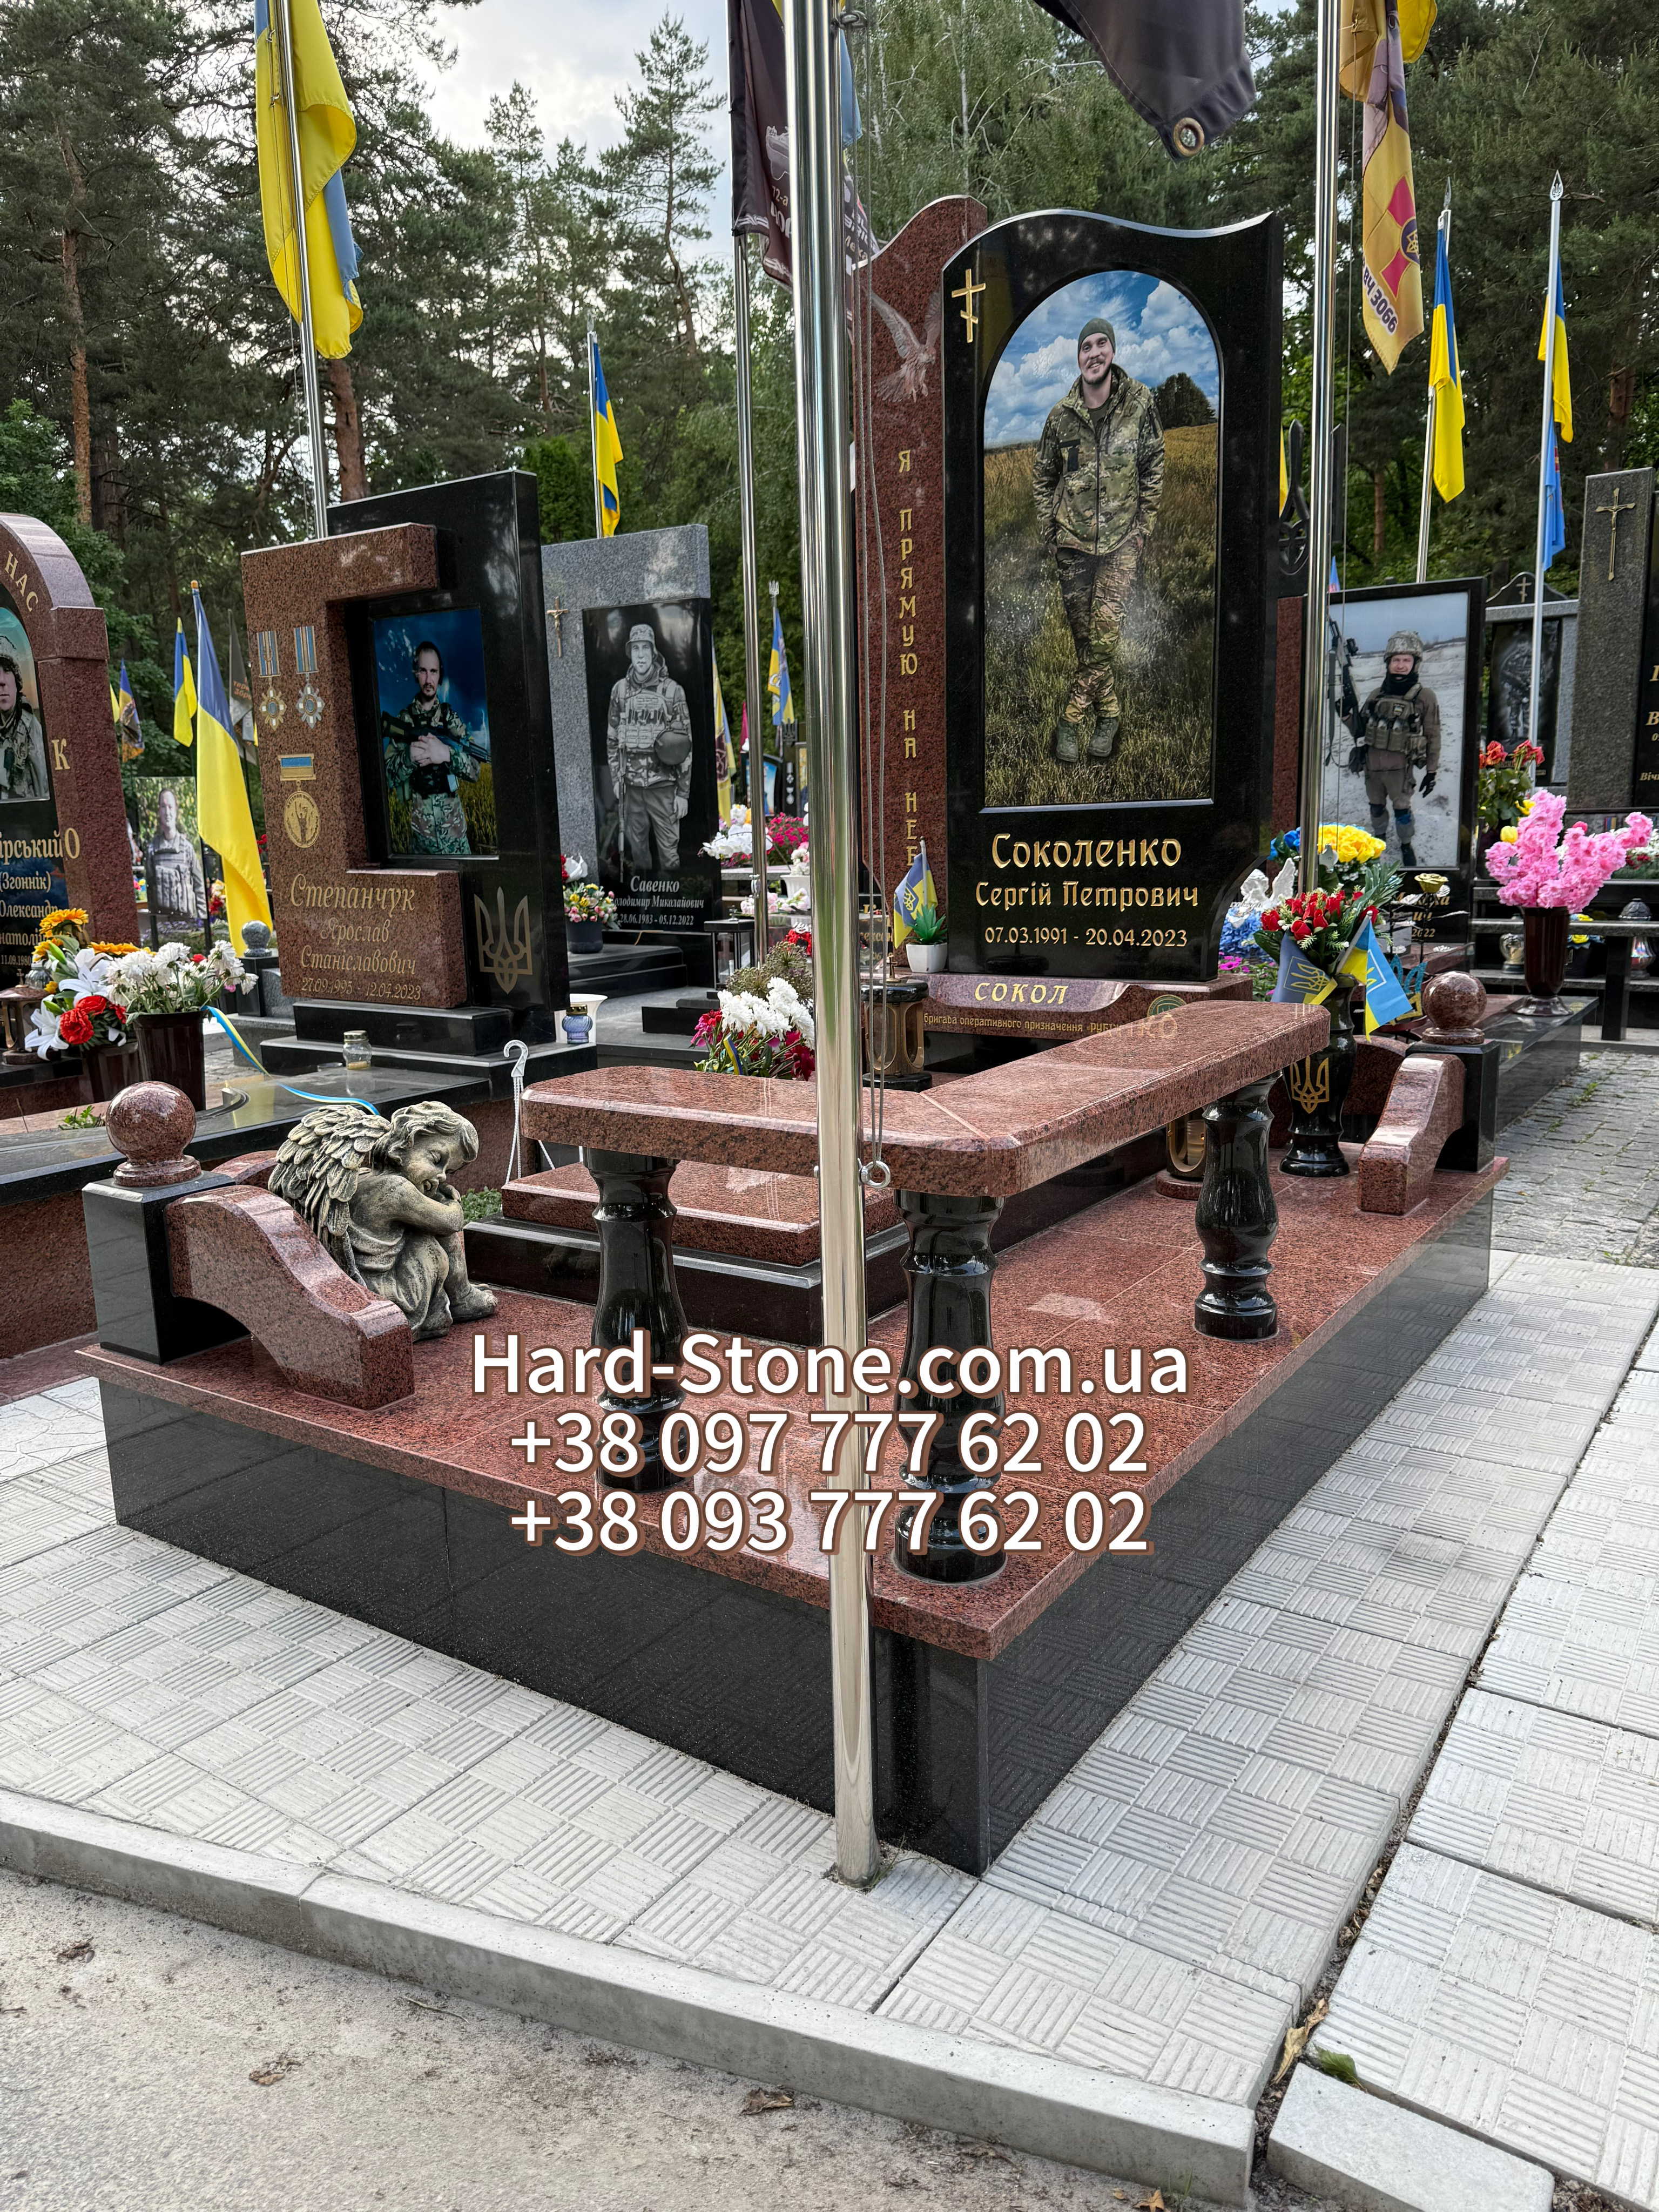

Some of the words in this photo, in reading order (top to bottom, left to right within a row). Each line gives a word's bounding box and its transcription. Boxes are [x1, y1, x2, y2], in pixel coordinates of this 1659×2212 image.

[1370, 289, 1398, 333] 3066
[899, 449, 911, 474] Я
[4, 550, 39, 612] НАС
[899, 507, 918, 676] ПРЯМУЮ
[903, 709, 917, 759] НА
[992, 833, 1182, 869] Соколенко
[291, 873, 415, 918] Степанчук
[630, 875, 680, 893] Савенко
[975, 881, 1051, 911] Сергій
[1062, 880, 1199, 912] Петрович
[651, 895, 704, 908] Миколайович
[320, 917, 390, 945] Ярослав
[659, 914, 694, 926] 05.12.2022
[984, 926, 1067, 945] 07.03.1991
[1085, 927, 1188, 948] 20.04.2023
[300, 945, 416, 974] Станіславович
[301, 977, 353, 995] 27.09.1995
[366, 982, 421, 1000] 12.04.2023
[974, 982, 1069, 1004] СОКОЛ
[960, 1017, 1022, 1029] оперативного
[1024, 1020, 1083, 1033] призначення
